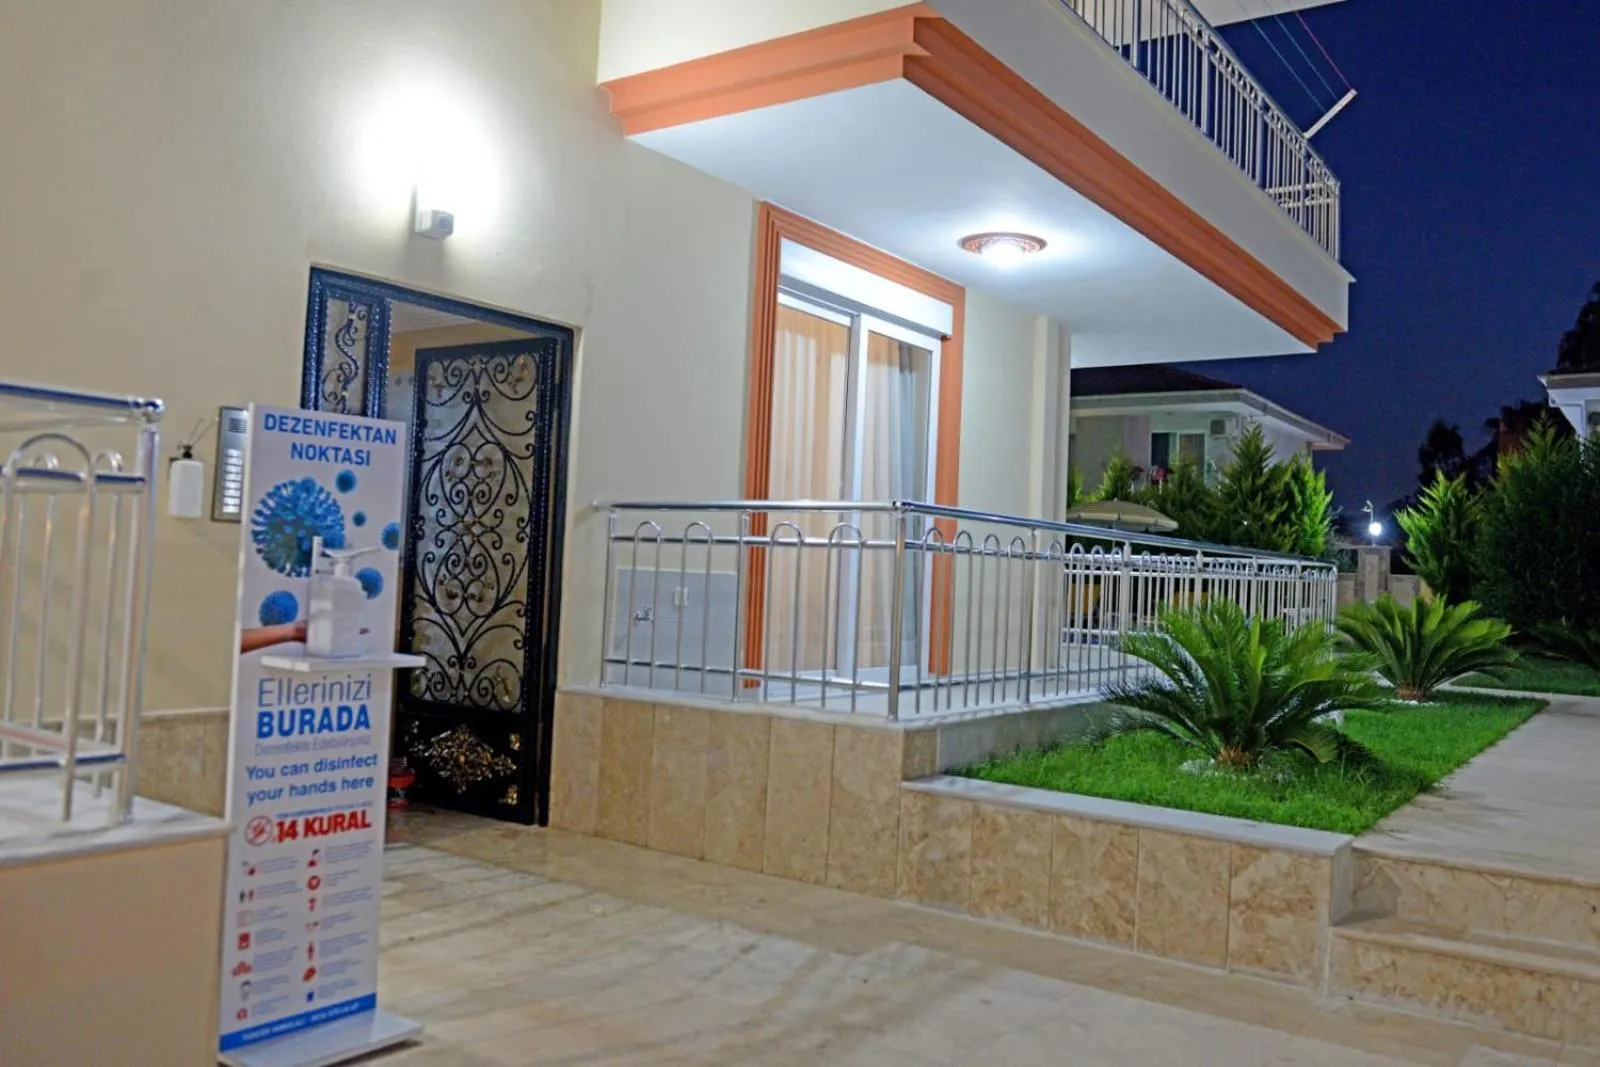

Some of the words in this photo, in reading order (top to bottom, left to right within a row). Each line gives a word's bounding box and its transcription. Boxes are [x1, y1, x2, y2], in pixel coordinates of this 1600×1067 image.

[264, 413, 396, 445] DEZENFEKTAN
[291, 442, 371, 467] NOKTASI
[258, 673, 372, 707] Ellerinizi
[256, 704, 371, 739] BURADA
[246, 764, 275, 781] You
[281, 762, 308, 777] can
[314, 753, 378, 773] disinfect
[246, 787, 283, 807] your
[289, 779, 336, 797] hands
[341, 775, 374, 791] here
[276, 819, 299, 843] 14
[303, 809, 372, 838] KURAL
